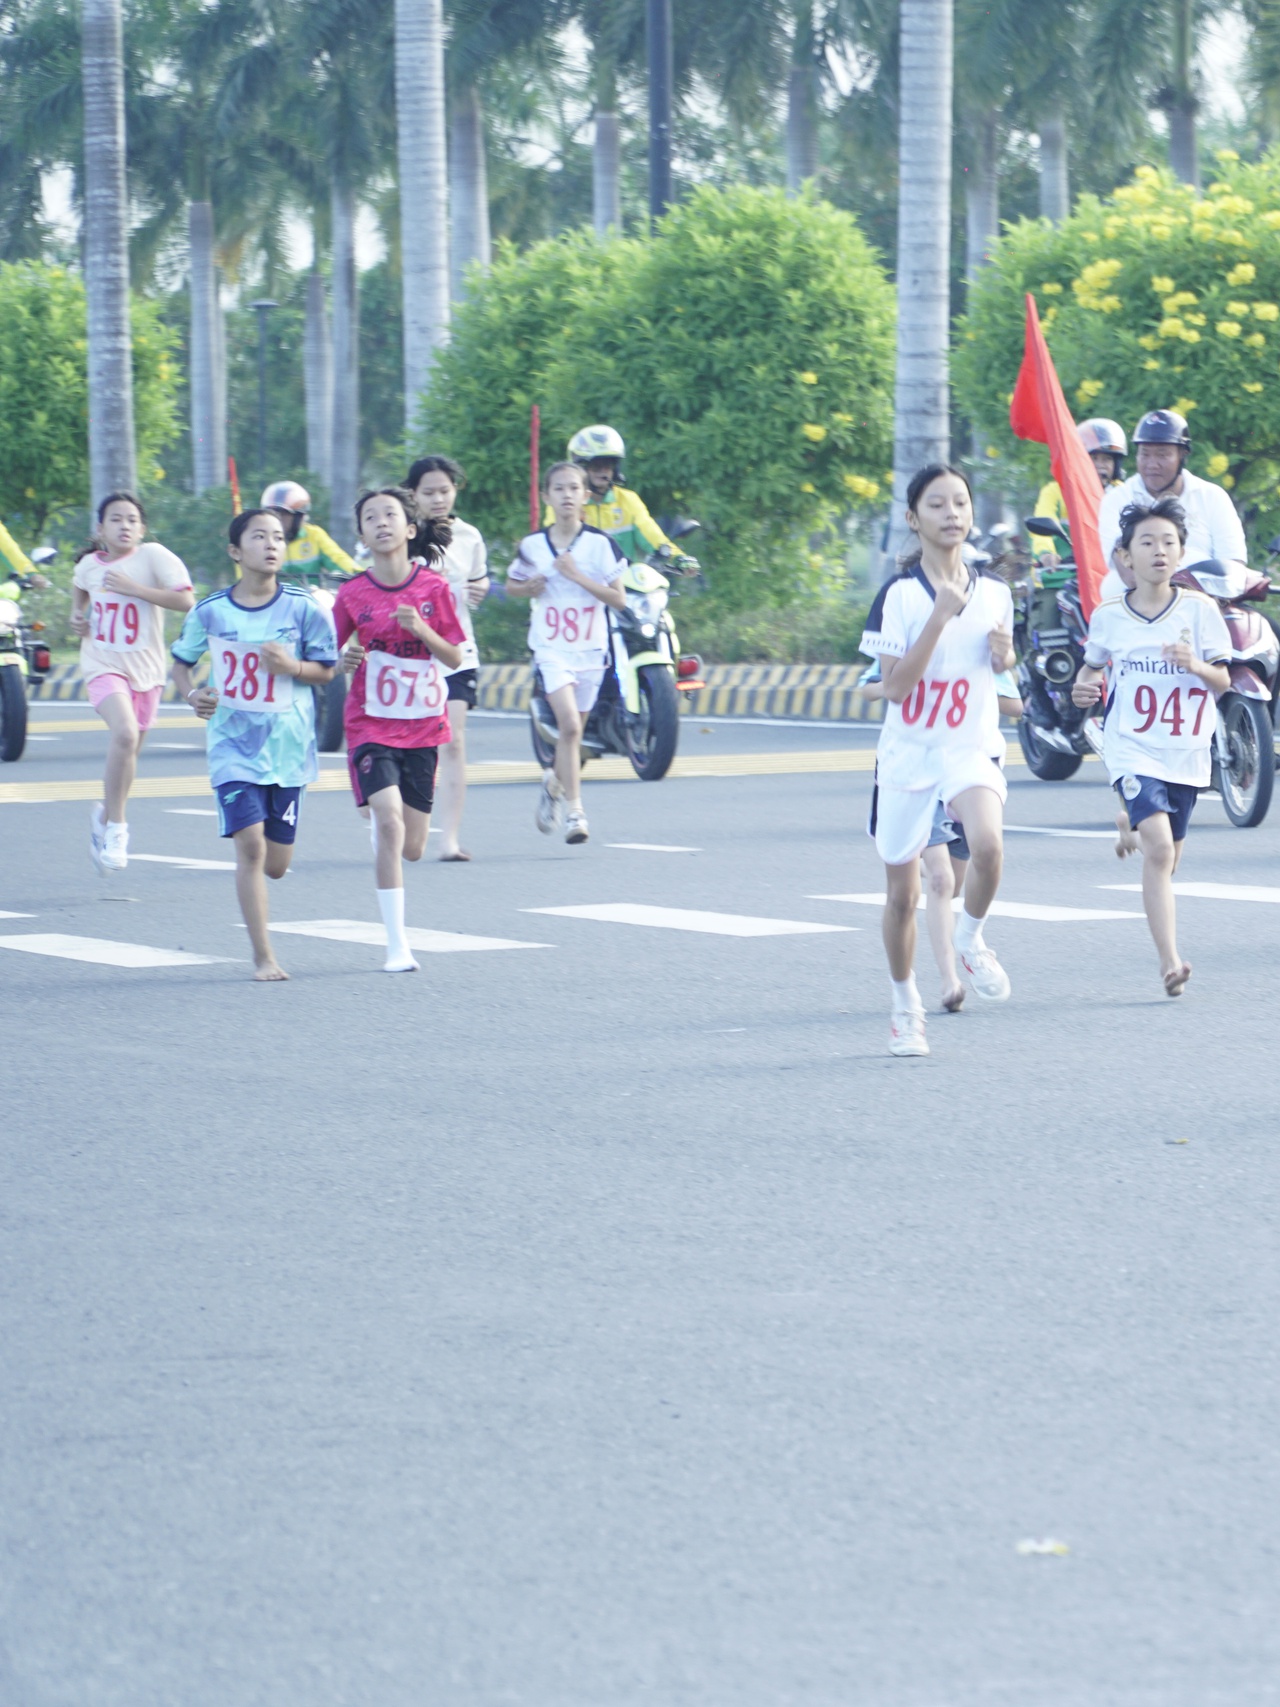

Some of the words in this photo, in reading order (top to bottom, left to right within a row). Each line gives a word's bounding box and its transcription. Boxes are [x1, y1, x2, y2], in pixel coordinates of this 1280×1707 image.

[94, 601, 140, 645] 279
[545, 606, 596, 643] 987
[222, 650, 276, 703] 281
[376, 663, 442, 708] 673
[901, 678, 970, 730] 078
[1132, 684, 1209, 736] 947
[281, 799, 297, 826] 4
